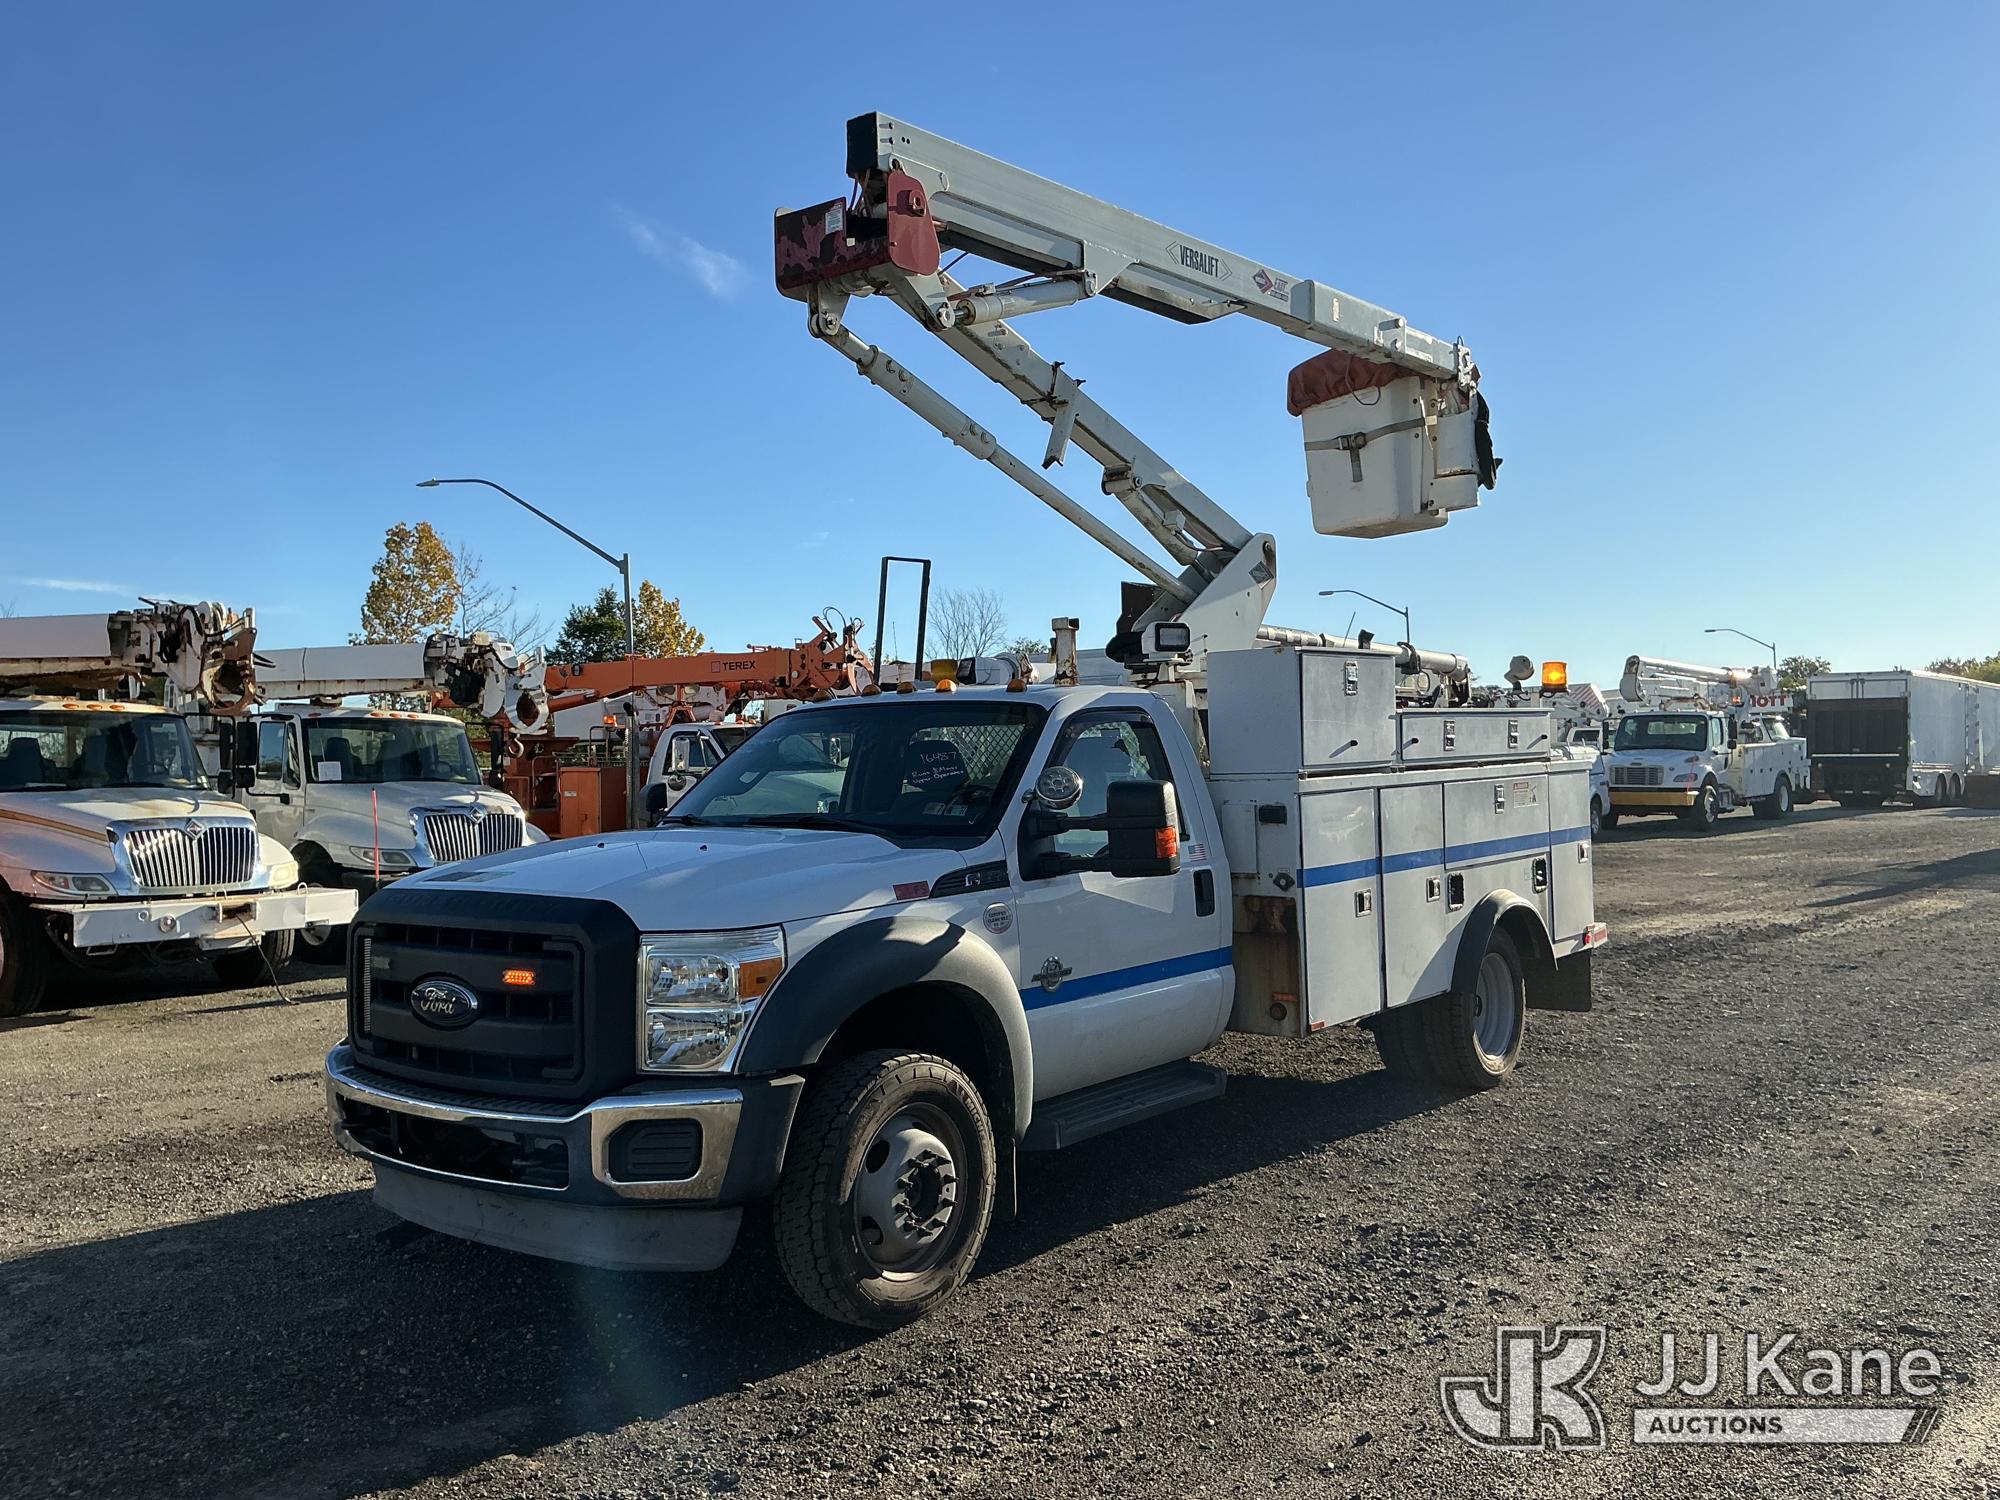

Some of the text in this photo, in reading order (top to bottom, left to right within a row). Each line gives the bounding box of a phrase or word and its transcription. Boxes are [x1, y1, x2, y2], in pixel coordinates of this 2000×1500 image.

[1179, 244, 1219, 278] VERSALIFT
[722, 660, 756, 671] TEREX
[1750, 695, 1786, 707] IOTT
[920, 751, 957, 765] 16487
[421, 987, 456, 1014] Ford
